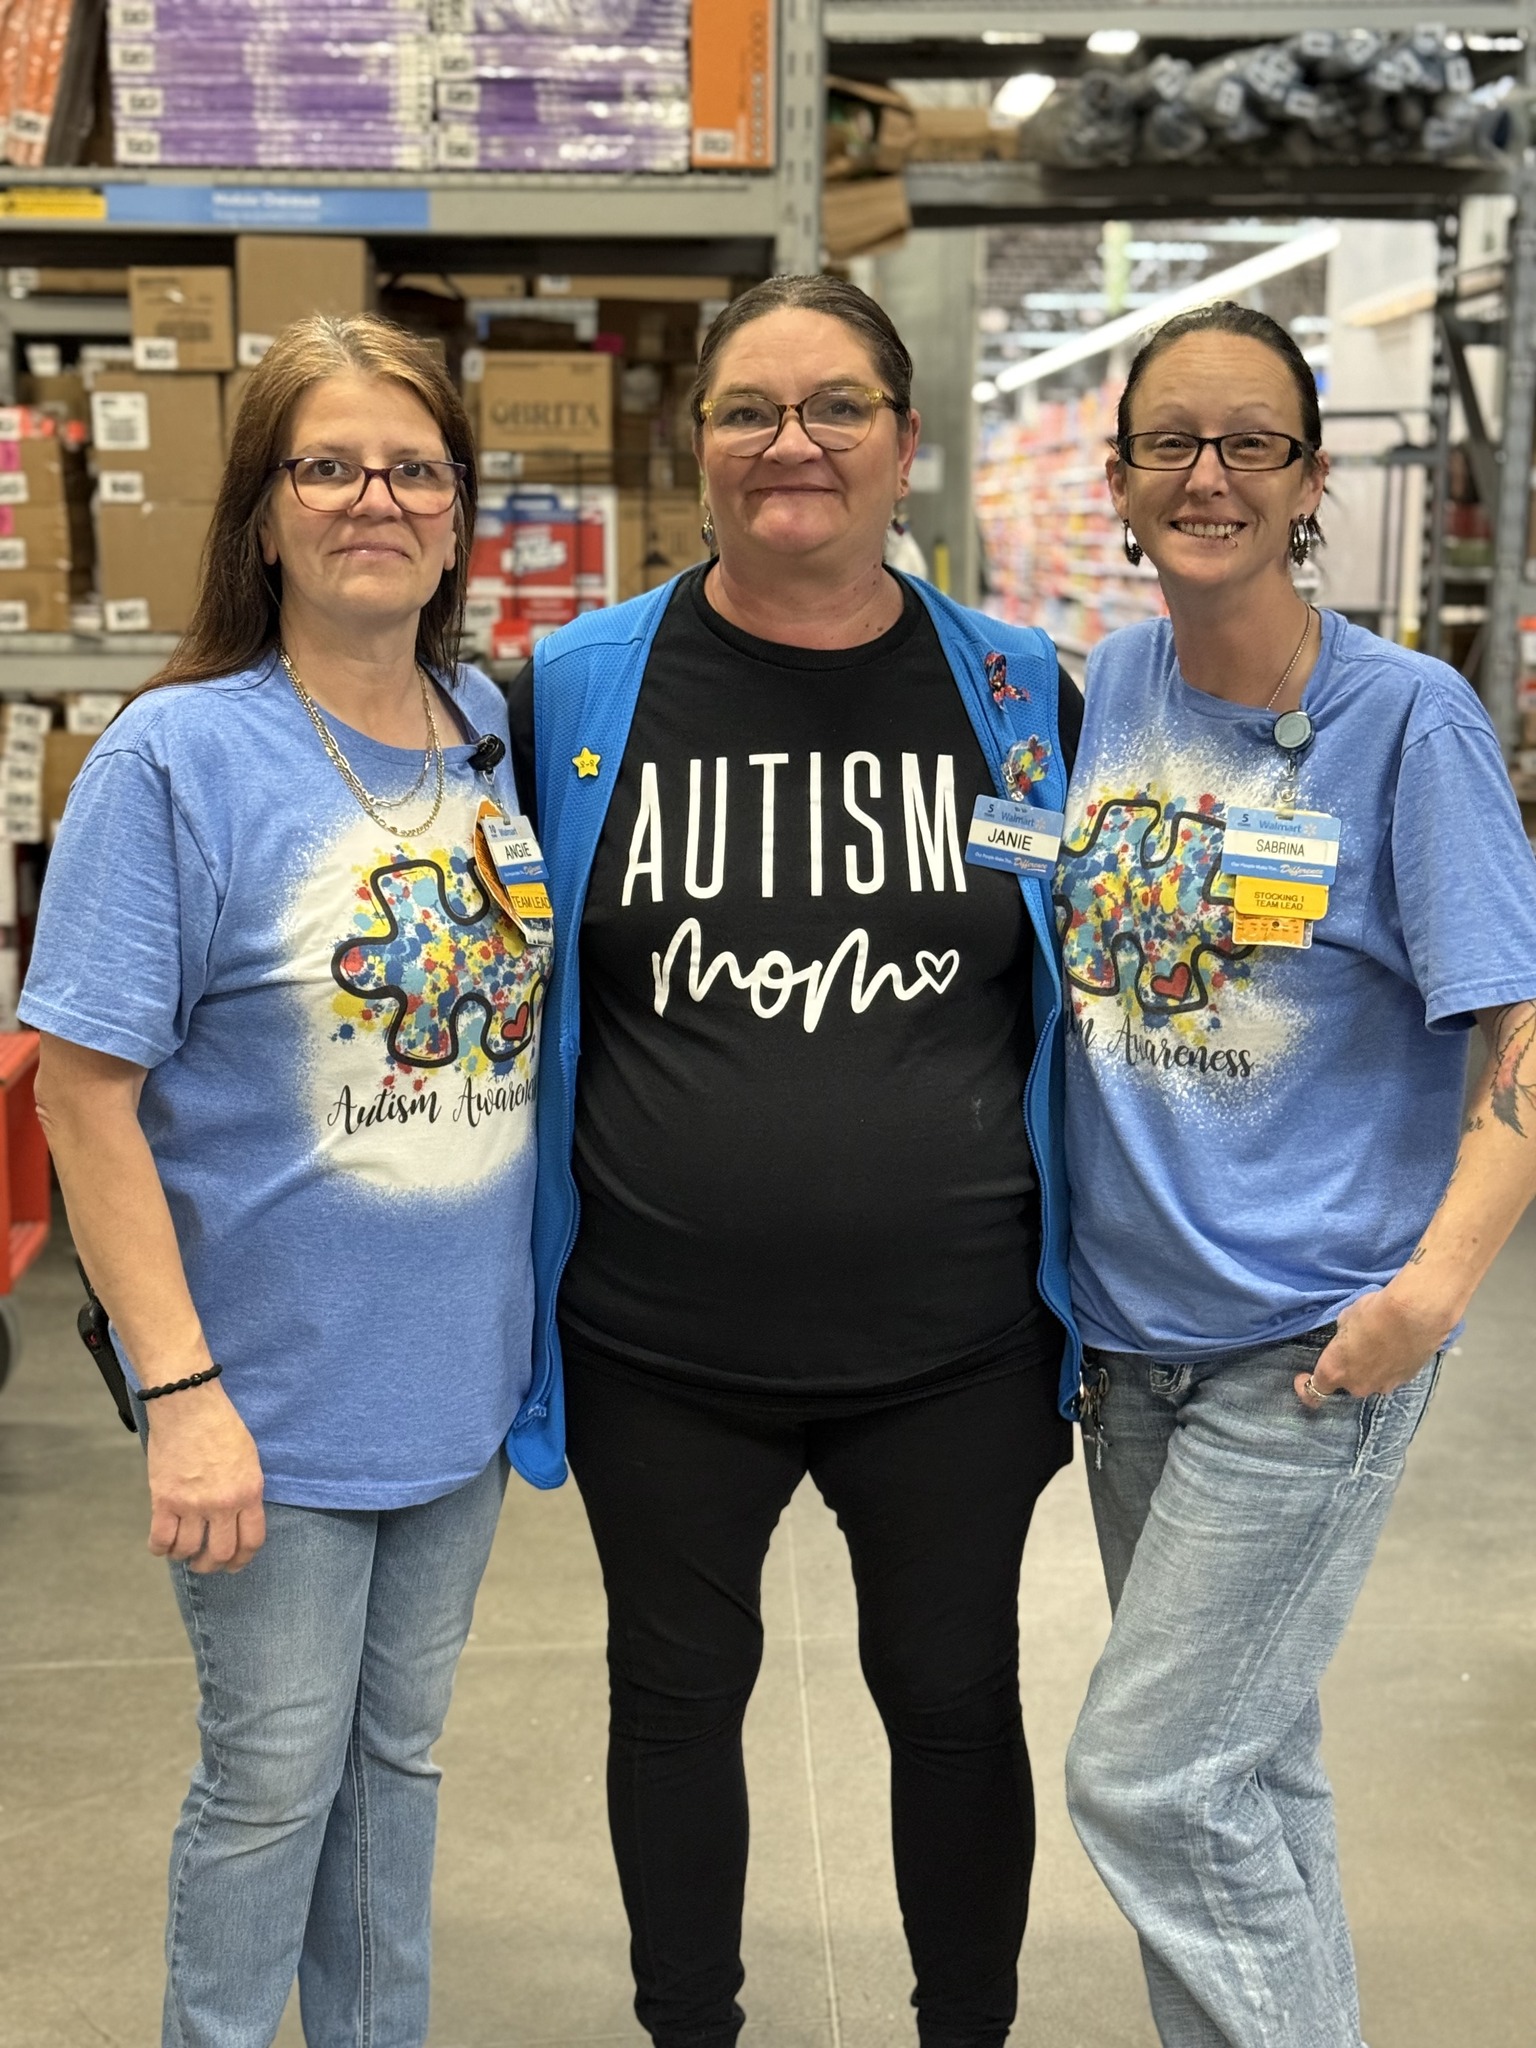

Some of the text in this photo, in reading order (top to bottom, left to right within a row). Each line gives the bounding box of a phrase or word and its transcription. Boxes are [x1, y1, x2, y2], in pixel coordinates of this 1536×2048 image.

[1001, 811, 1035, 827] Walmart
[1242, 813, 1249, 823] 5
[1259, 820, 1302, 833] Walmart
[621, 751, 967, 907] AUTISM
[987, 828, 1033, 851] JANIE
[1256, 838, 1305, 857] SABRINA
[504, 842, 532, 860] ANGIE
[511, 896, 551, 909] TEAM LEAD
[1253, 891, 1298, 902] STOCKING
[1256, 899, 1303, 910] TEAM LEAD
[1107, 1014, 1255, 1078] Awareness
[327, 1084, 443, 1135] Autism
